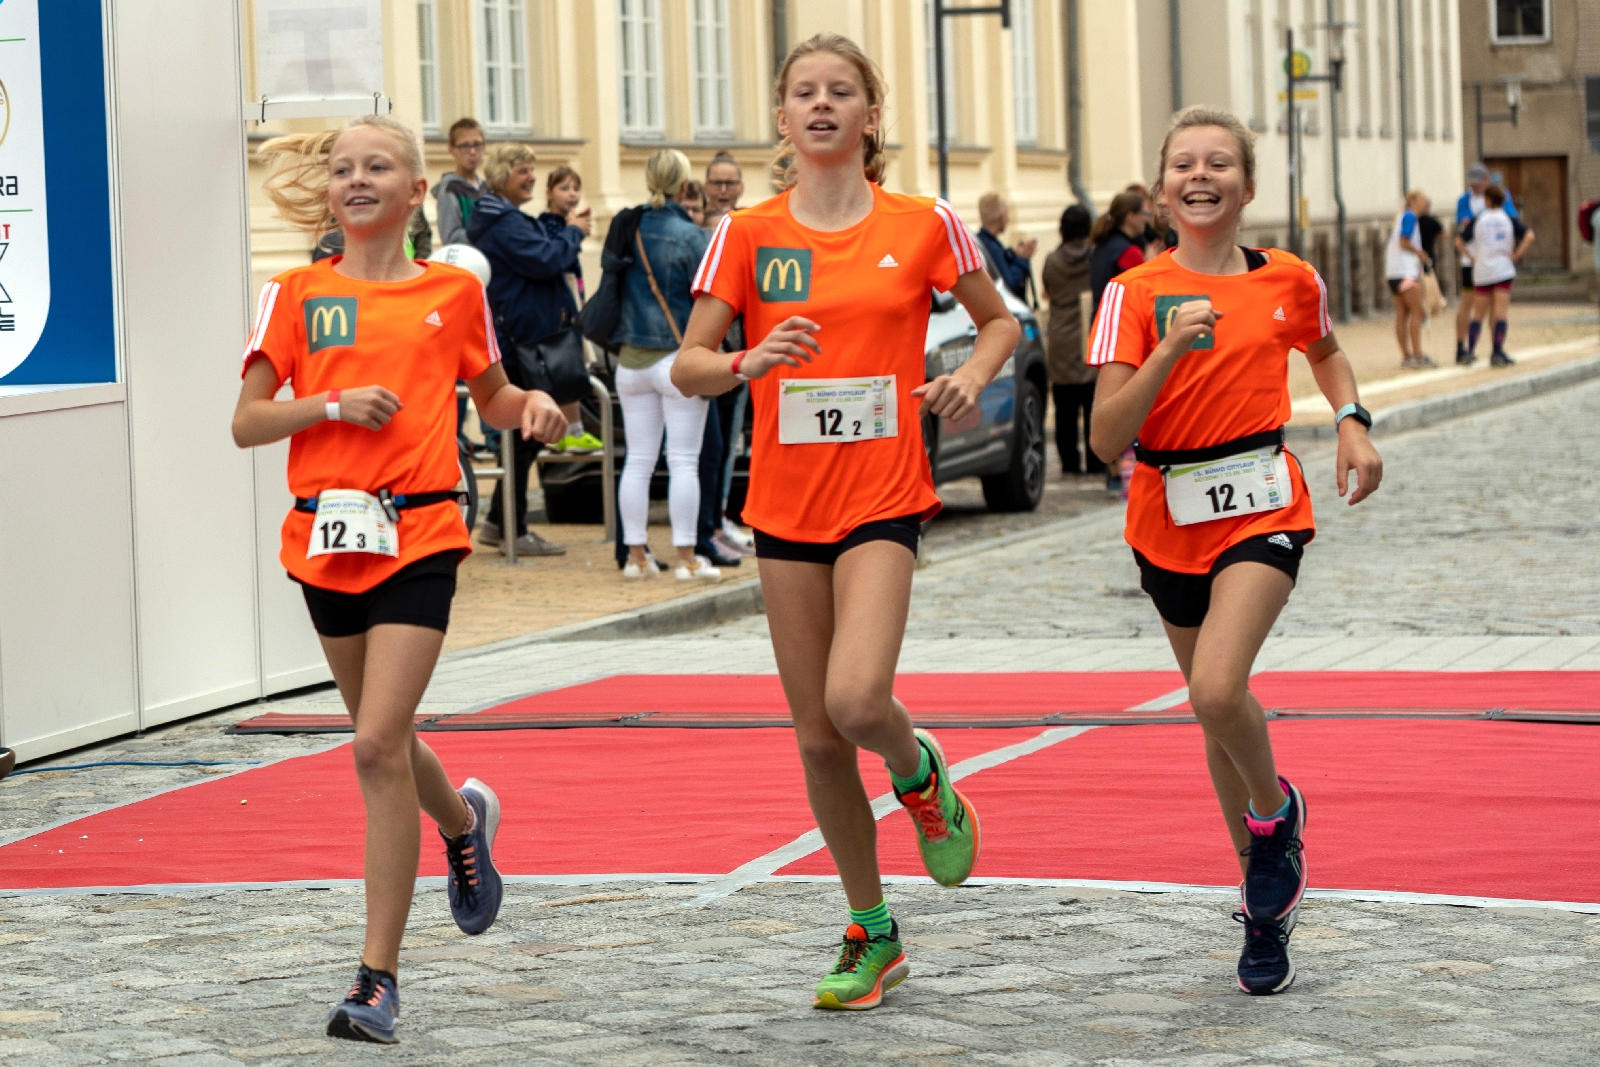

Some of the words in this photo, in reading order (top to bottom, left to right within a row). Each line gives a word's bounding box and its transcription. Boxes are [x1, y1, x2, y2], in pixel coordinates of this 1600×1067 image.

[815, 409, 843, 436] 12
[853, 420, 862, 436] 2
[1205, 483, 1237, 513] 12
[1246, 492, 1256, 507] 1
[320, 520, 347, 549] 12
[356, 533, 366, 549] 3
